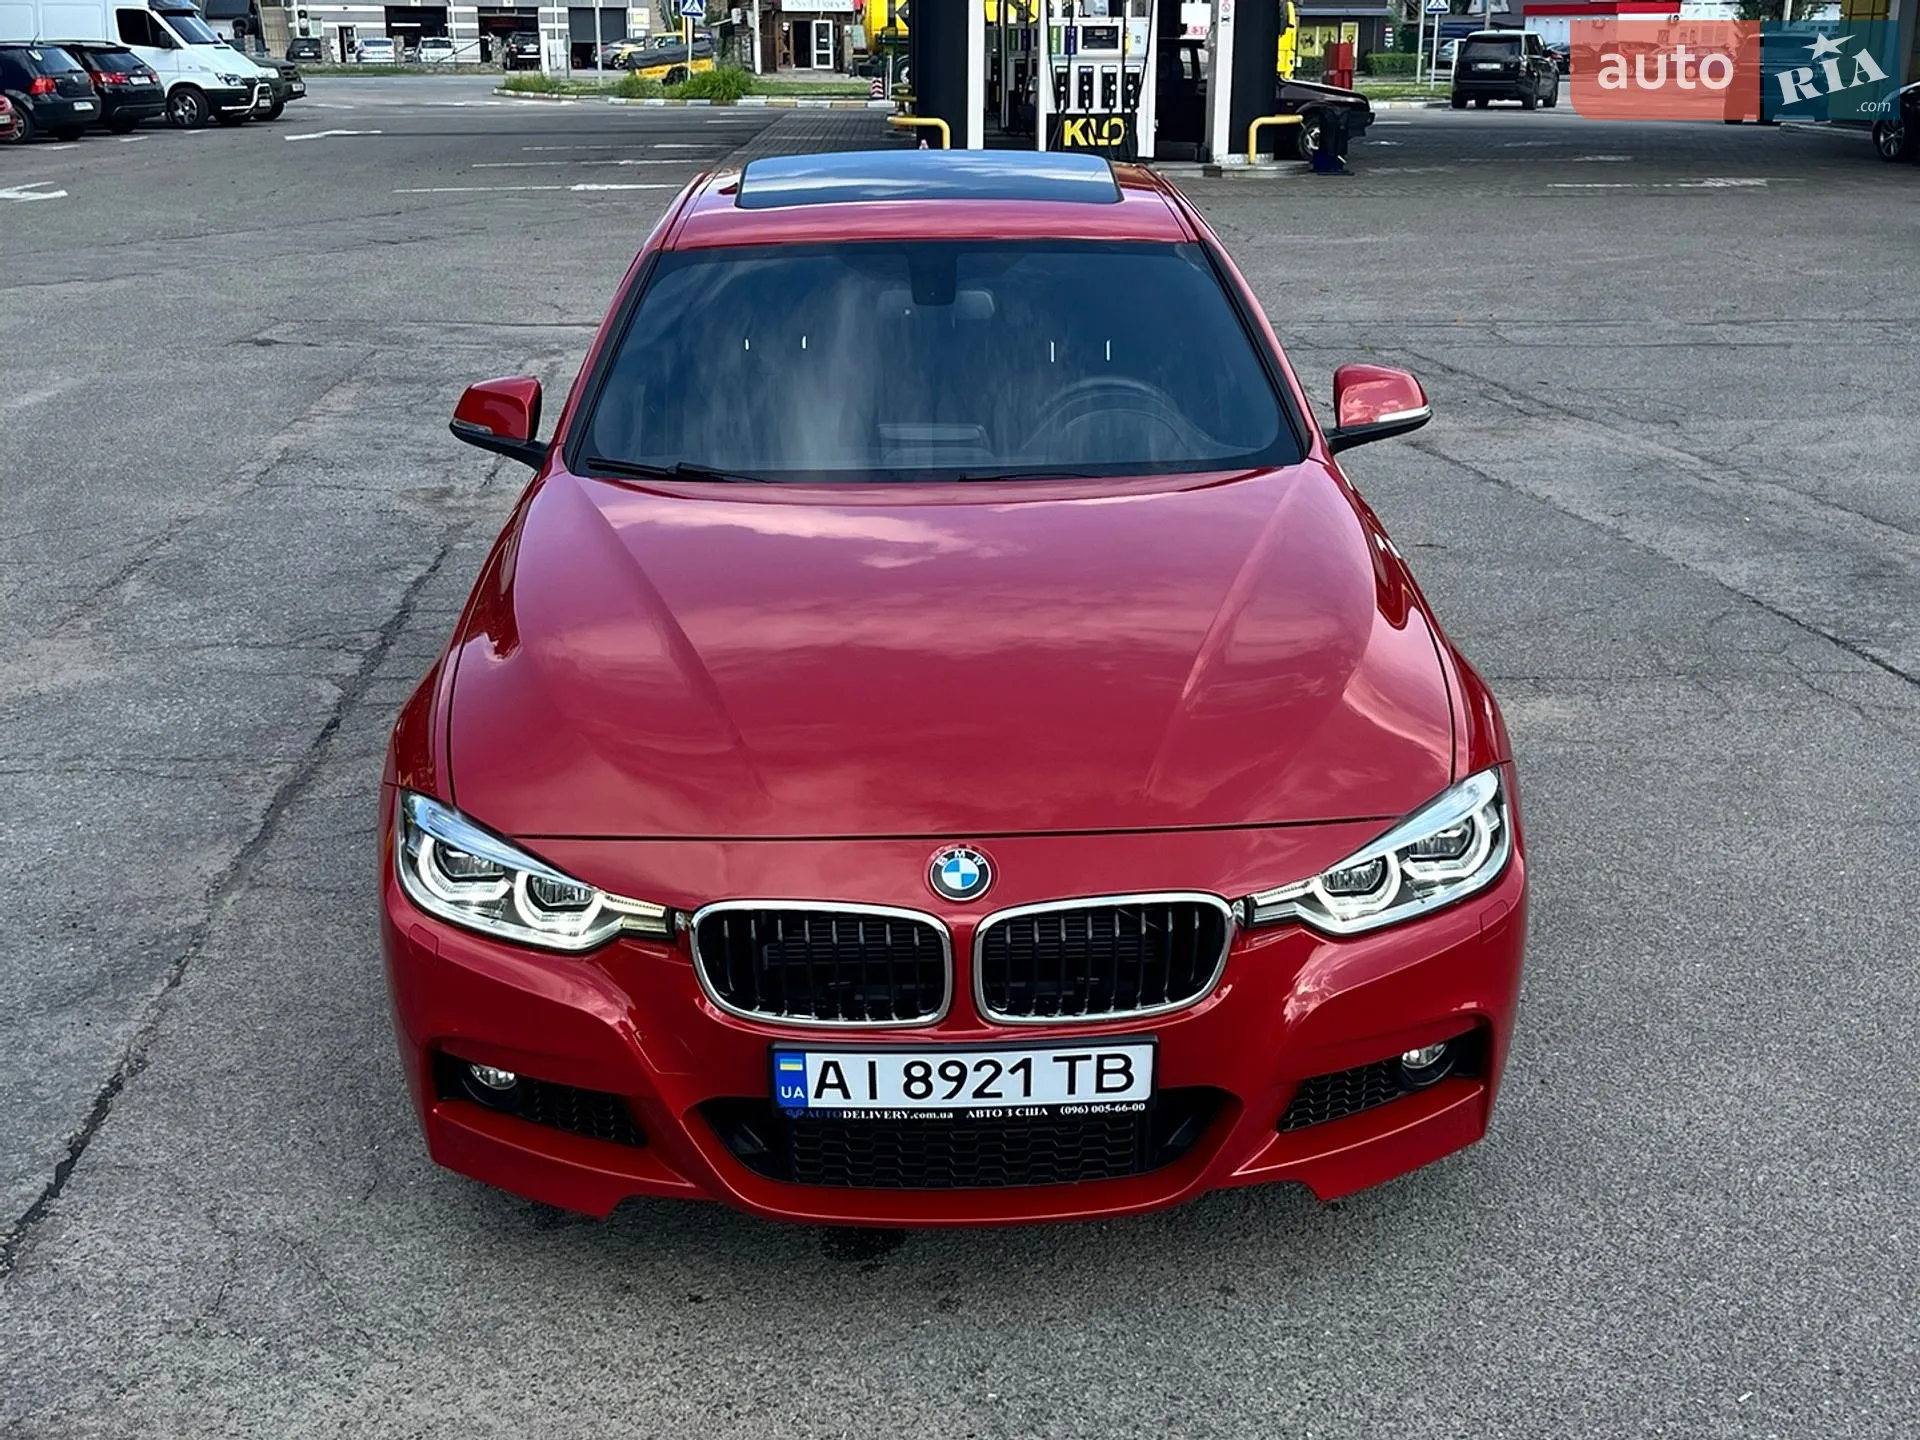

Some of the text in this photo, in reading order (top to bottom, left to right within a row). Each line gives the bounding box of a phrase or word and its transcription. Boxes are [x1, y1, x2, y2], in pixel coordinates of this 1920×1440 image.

[1063, 117, 1125, 146] KLO
[937, 849, 985, 867] BMW
[813, 1053, 1135, 1100] AI 8921 TB
[781, 1086, 805, 1099] UA
[966, 1108, 1002, 1119] АВТО
[1015, 1106, 1048, 1117] США
[1060, 1105, 1088, 1115] (096)
[1091, 1102, 1146, 1114] 005-66-00
